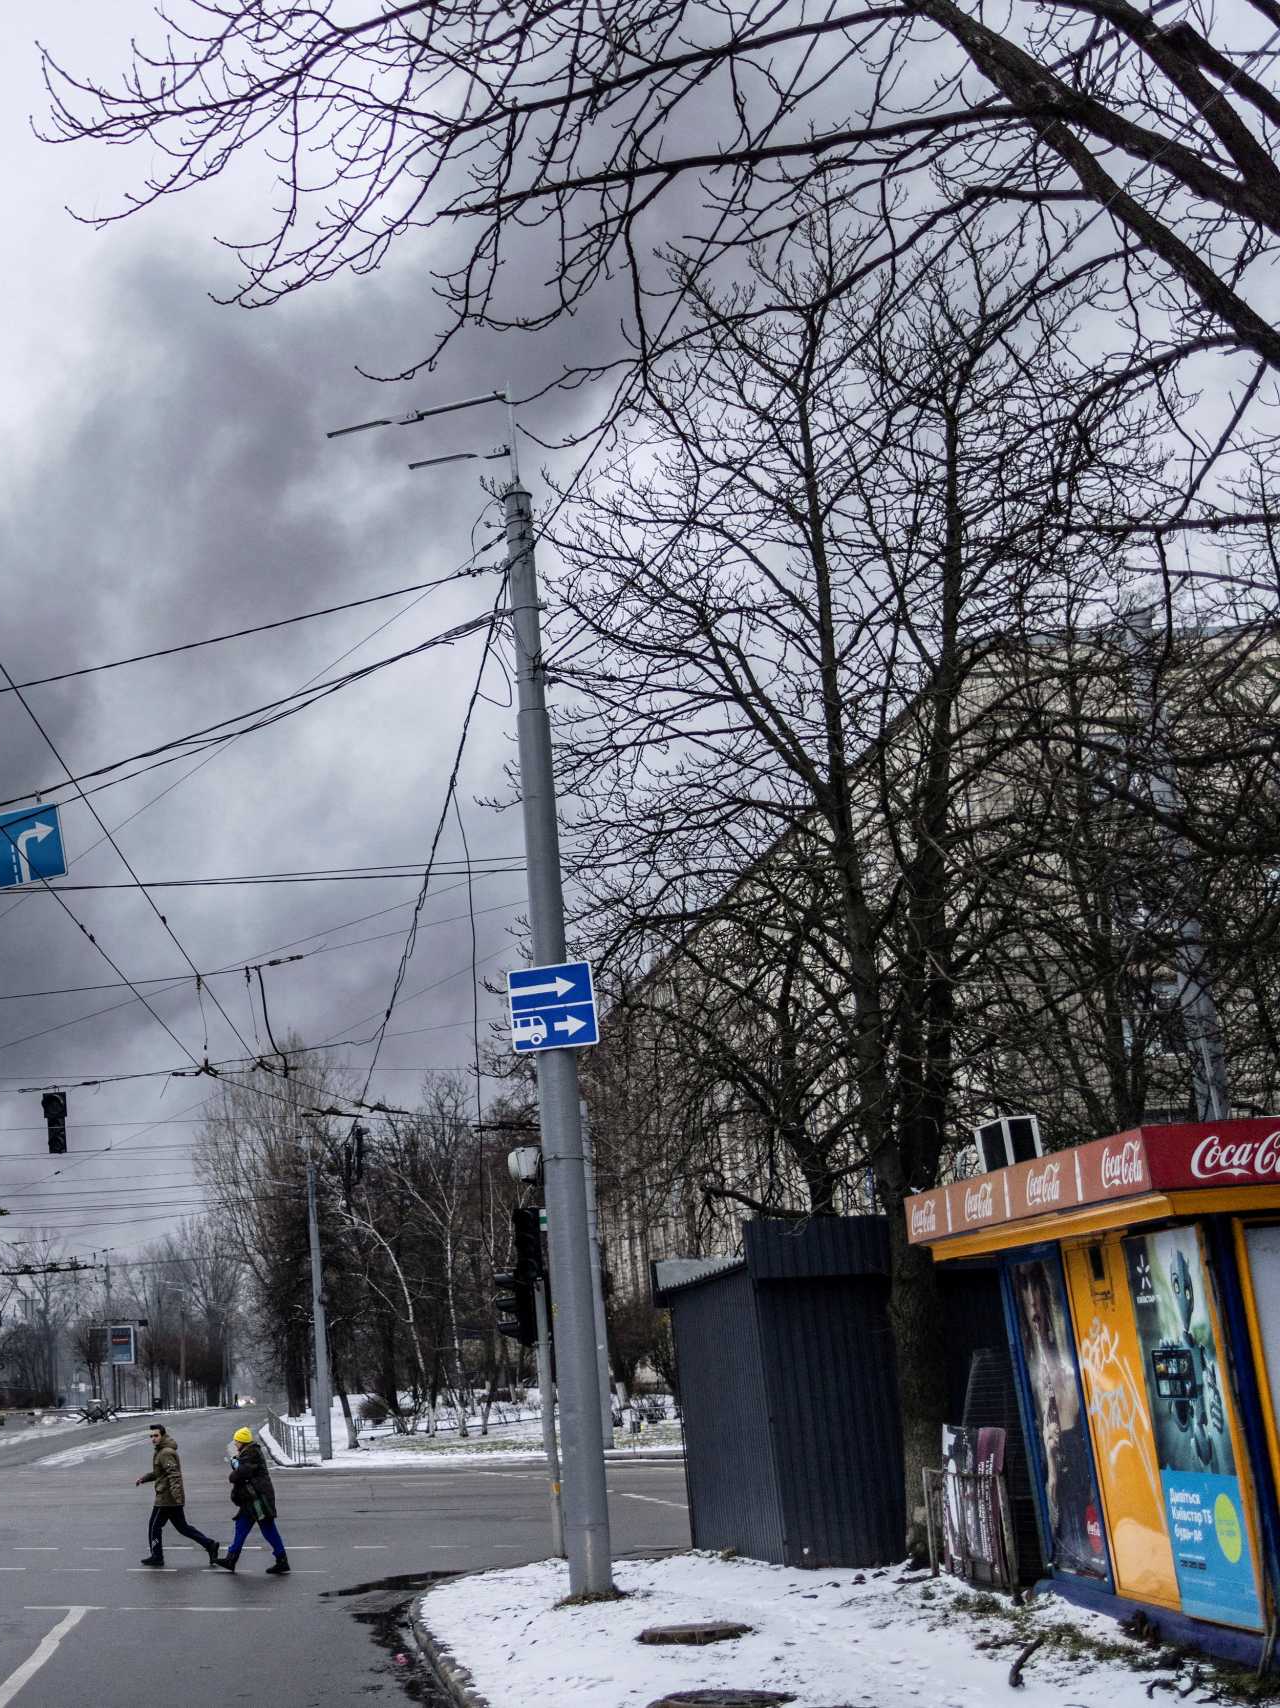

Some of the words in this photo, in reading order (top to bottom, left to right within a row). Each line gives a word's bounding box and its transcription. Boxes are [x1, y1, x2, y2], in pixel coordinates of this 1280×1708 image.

[1026, 1161, 1060, 1206] Coca-Cola
[1101, 1140, 1143, 1189] Coca-Cola
[912, 1199, 936, 1236] Coca-Cola
[965, 1181, 993, 1222] Coca-Cola
[1171, 1504, 1202, 1528] Київстар
